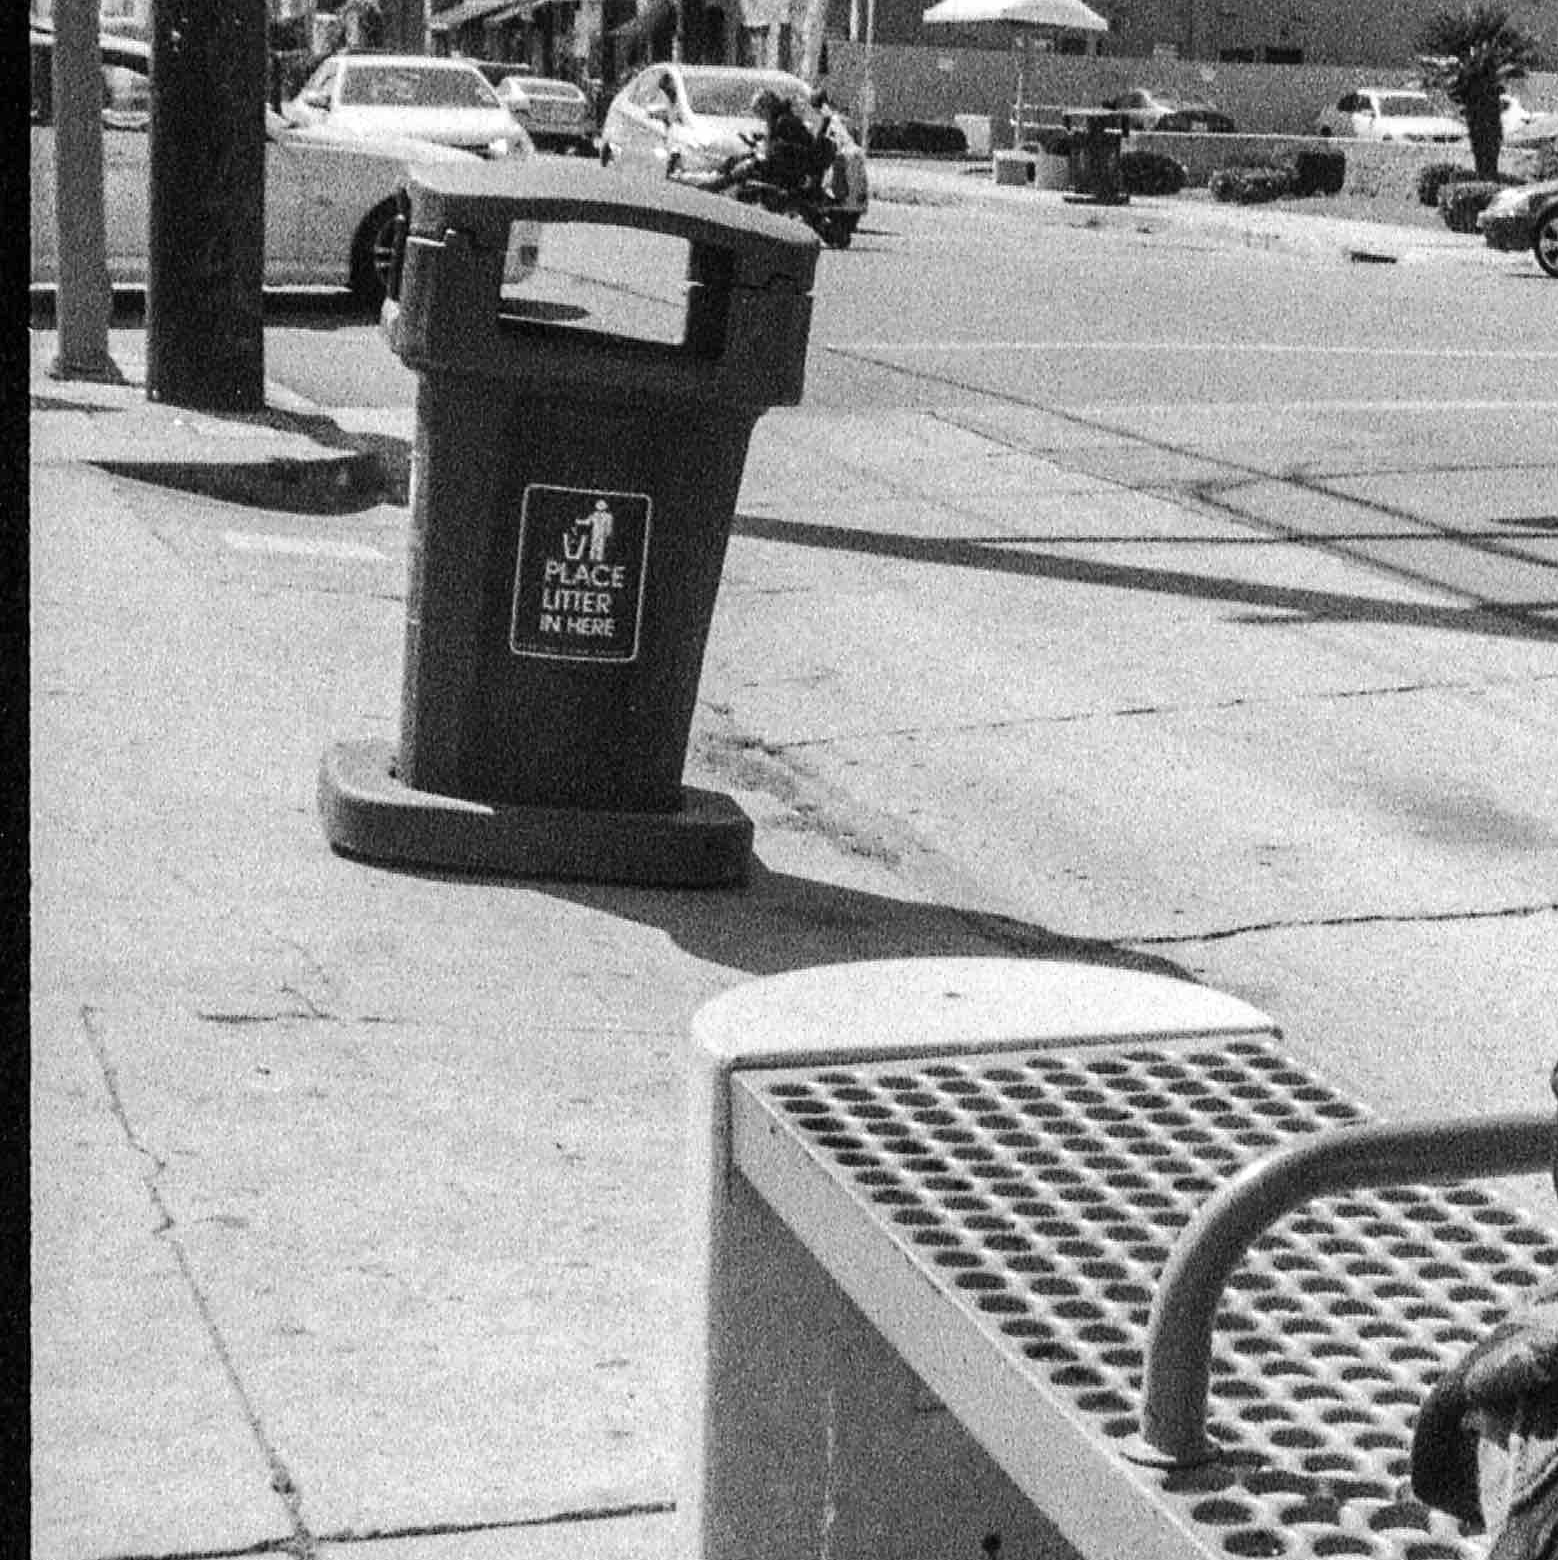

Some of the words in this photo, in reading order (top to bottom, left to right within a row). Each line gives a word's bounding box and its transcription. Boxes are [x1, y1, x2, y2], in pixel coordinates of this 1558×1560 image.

[545, 559, 626, 588] PLACE
[542, 589, 613, 614] LITTER
[540, 614, 561, 632] IN
[567, 617, 616, 637] HERE
